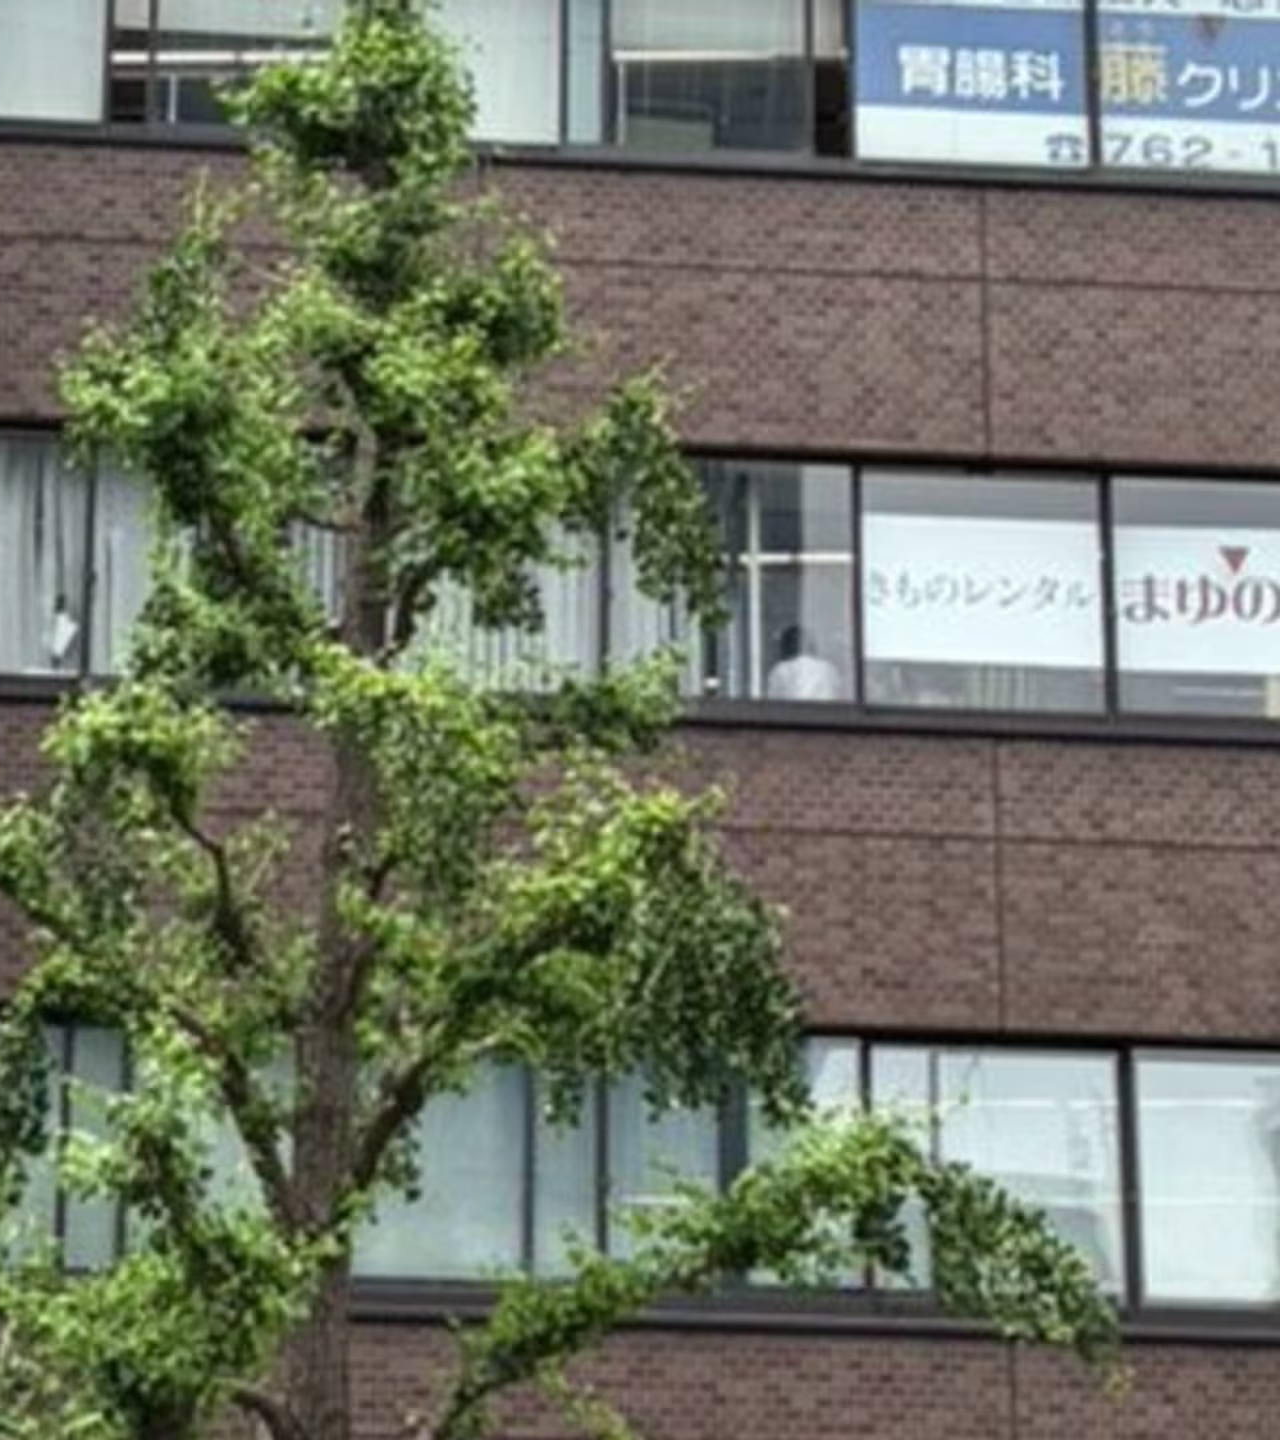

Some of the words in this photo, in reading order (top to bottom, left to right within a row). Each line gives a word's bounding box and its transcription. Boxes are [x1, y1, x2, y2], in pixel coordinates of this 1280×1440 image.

[898, 45, 1065, 102] 胃腸科
[867, 569, 1094, 613] きものレンタル
